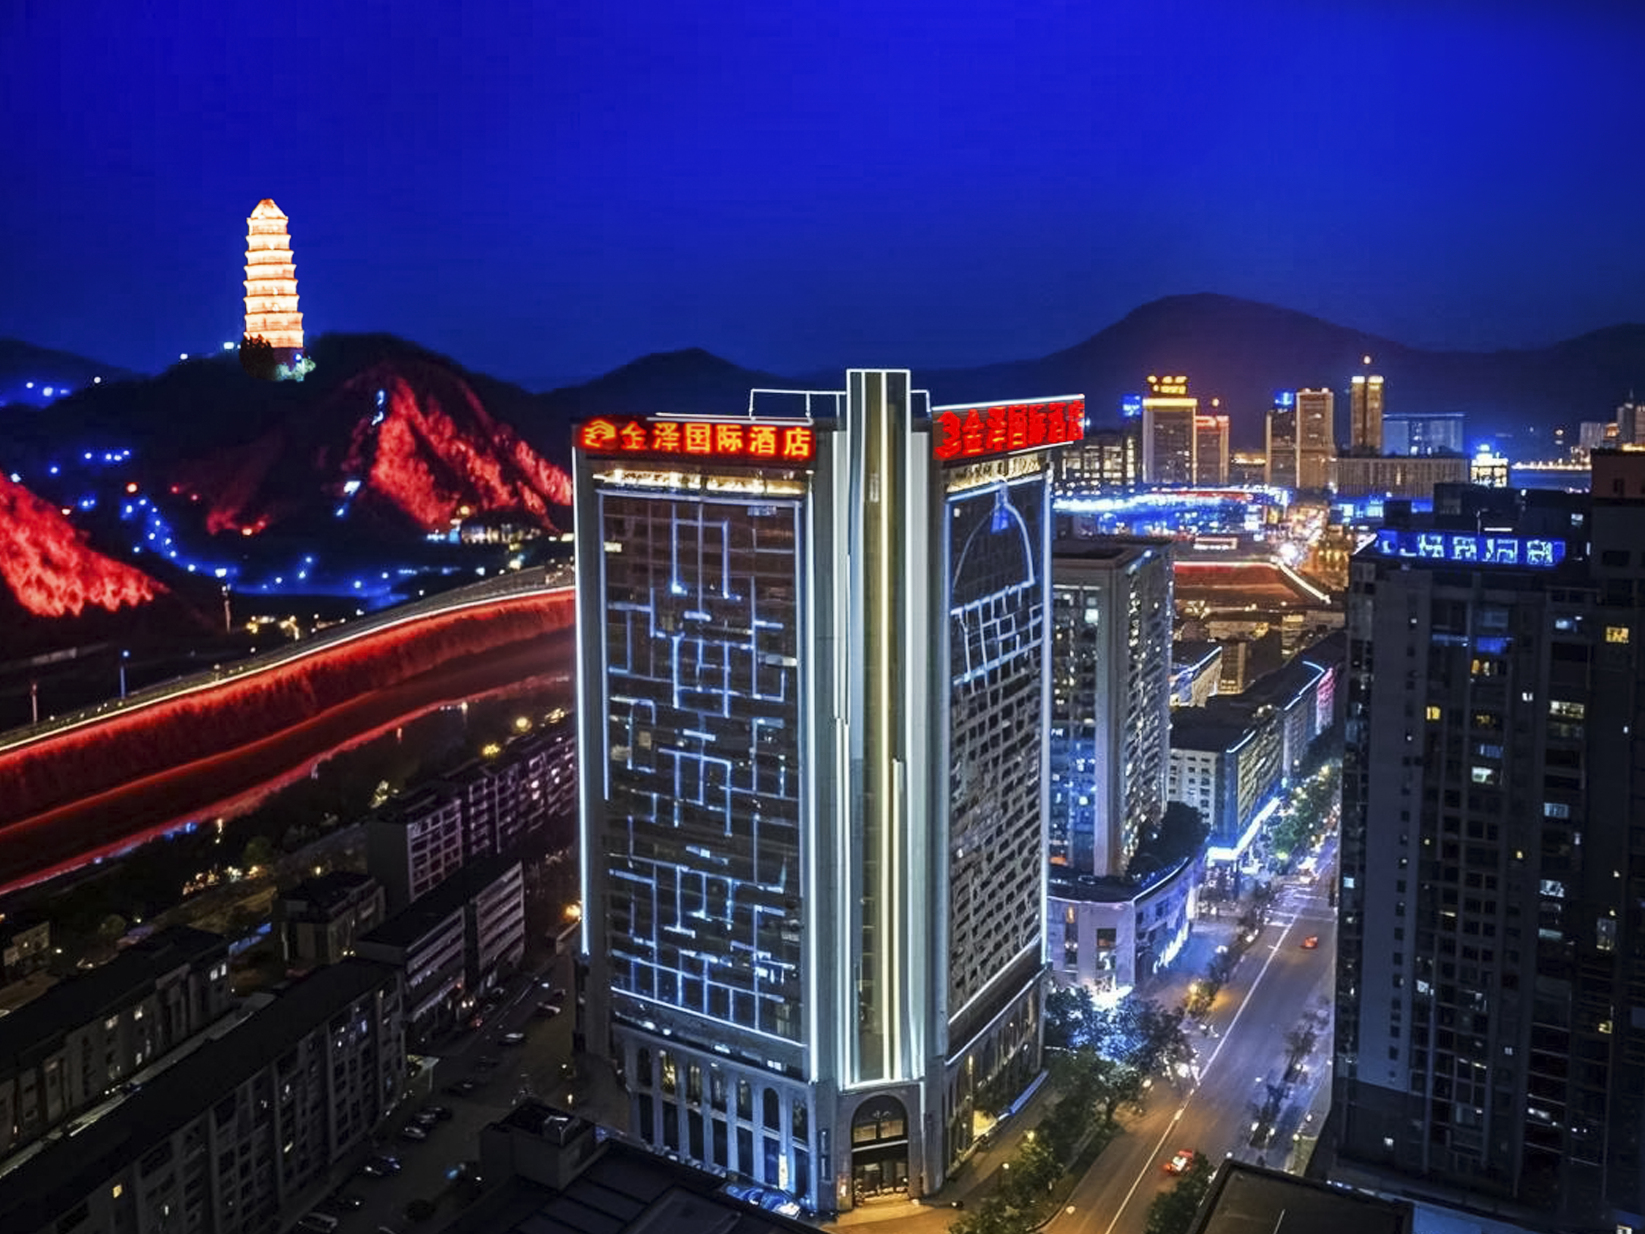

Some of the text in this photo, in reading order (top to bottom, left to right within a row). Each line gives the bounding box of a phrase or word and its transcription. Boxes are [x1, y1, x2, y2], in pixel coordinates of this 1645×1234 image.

[620, 420, 812, 457] 金泽国际酒店
